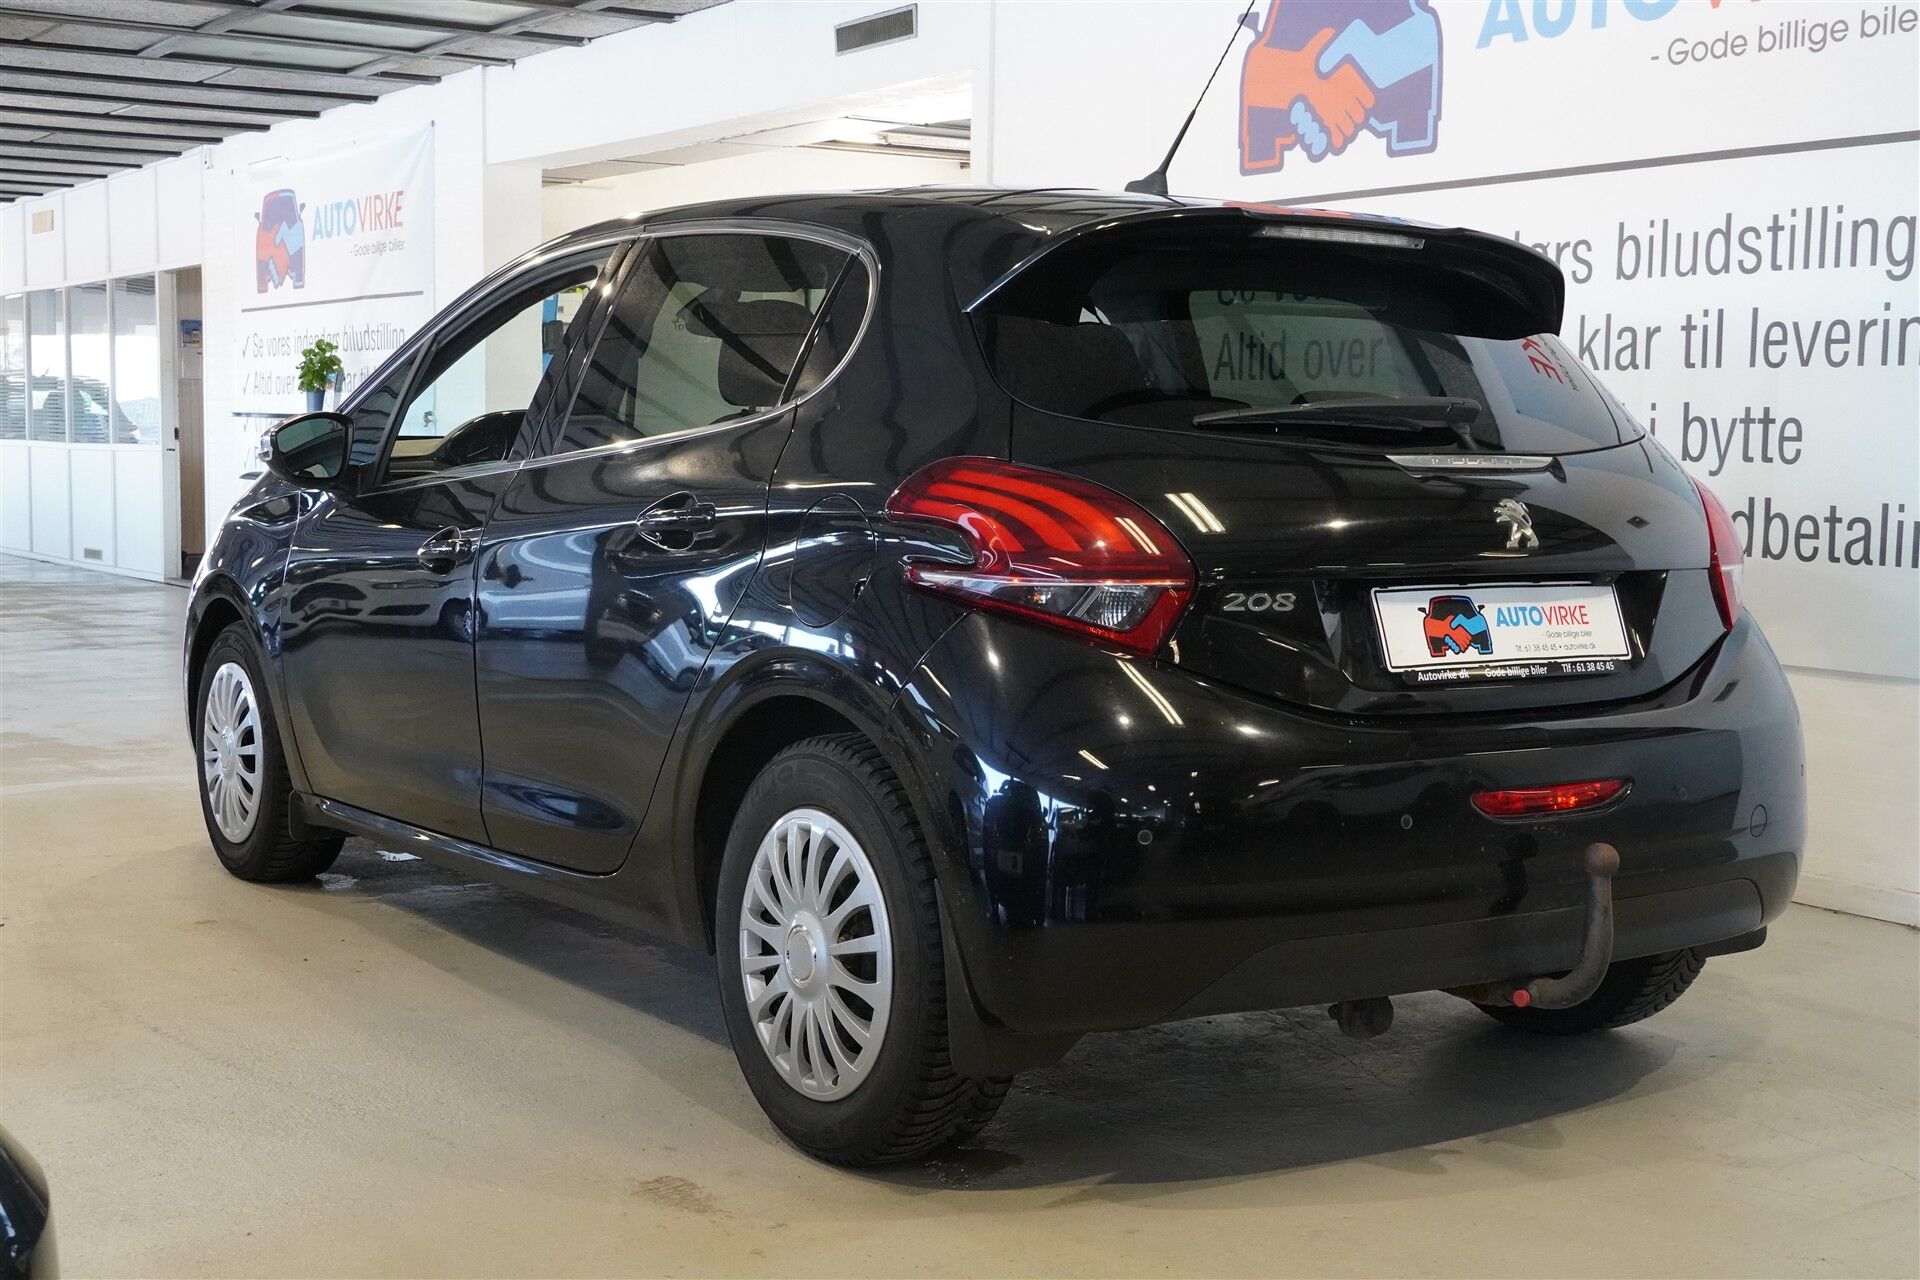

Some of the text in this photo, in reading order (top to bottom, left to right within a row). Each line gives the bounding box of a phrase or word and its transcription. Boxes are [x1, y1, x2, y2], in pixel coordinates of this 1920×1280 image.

[1667, 31, 1748, 66] Gode
[1757, 17, 1849, 53] billige
[312, 190, 404, 241] AUTOVIRKE
[1615, 205, 1917, 282] biludstilling
[253, 332, 263, 358] Se
[266, 336, 291, 357] vores
[1213, 329, 1385, 382] Altid over
[1579, 313, 1661, 371] klar
[1680, 308, 1725, 369] til
[253, 370, 272, 396] Altid
[276, 375, 295, 394] over
[1681, 402, 1803, 477] bytte
[1223, 592, 1296, 612] 208
[1496, 605, 1590, 627] AUTOVIRKE
[1485, 668, 1506, 678] Gode
[1507, 665, 1530, 678] billige
[1530, 665, 1548, 675] biler
[1576, 663, 1586, 672] 61
[1586, 662, 1596, 672] 38
[1596, 662, 1605, 671] 45
[1605, 661, 1615, 671] 45
